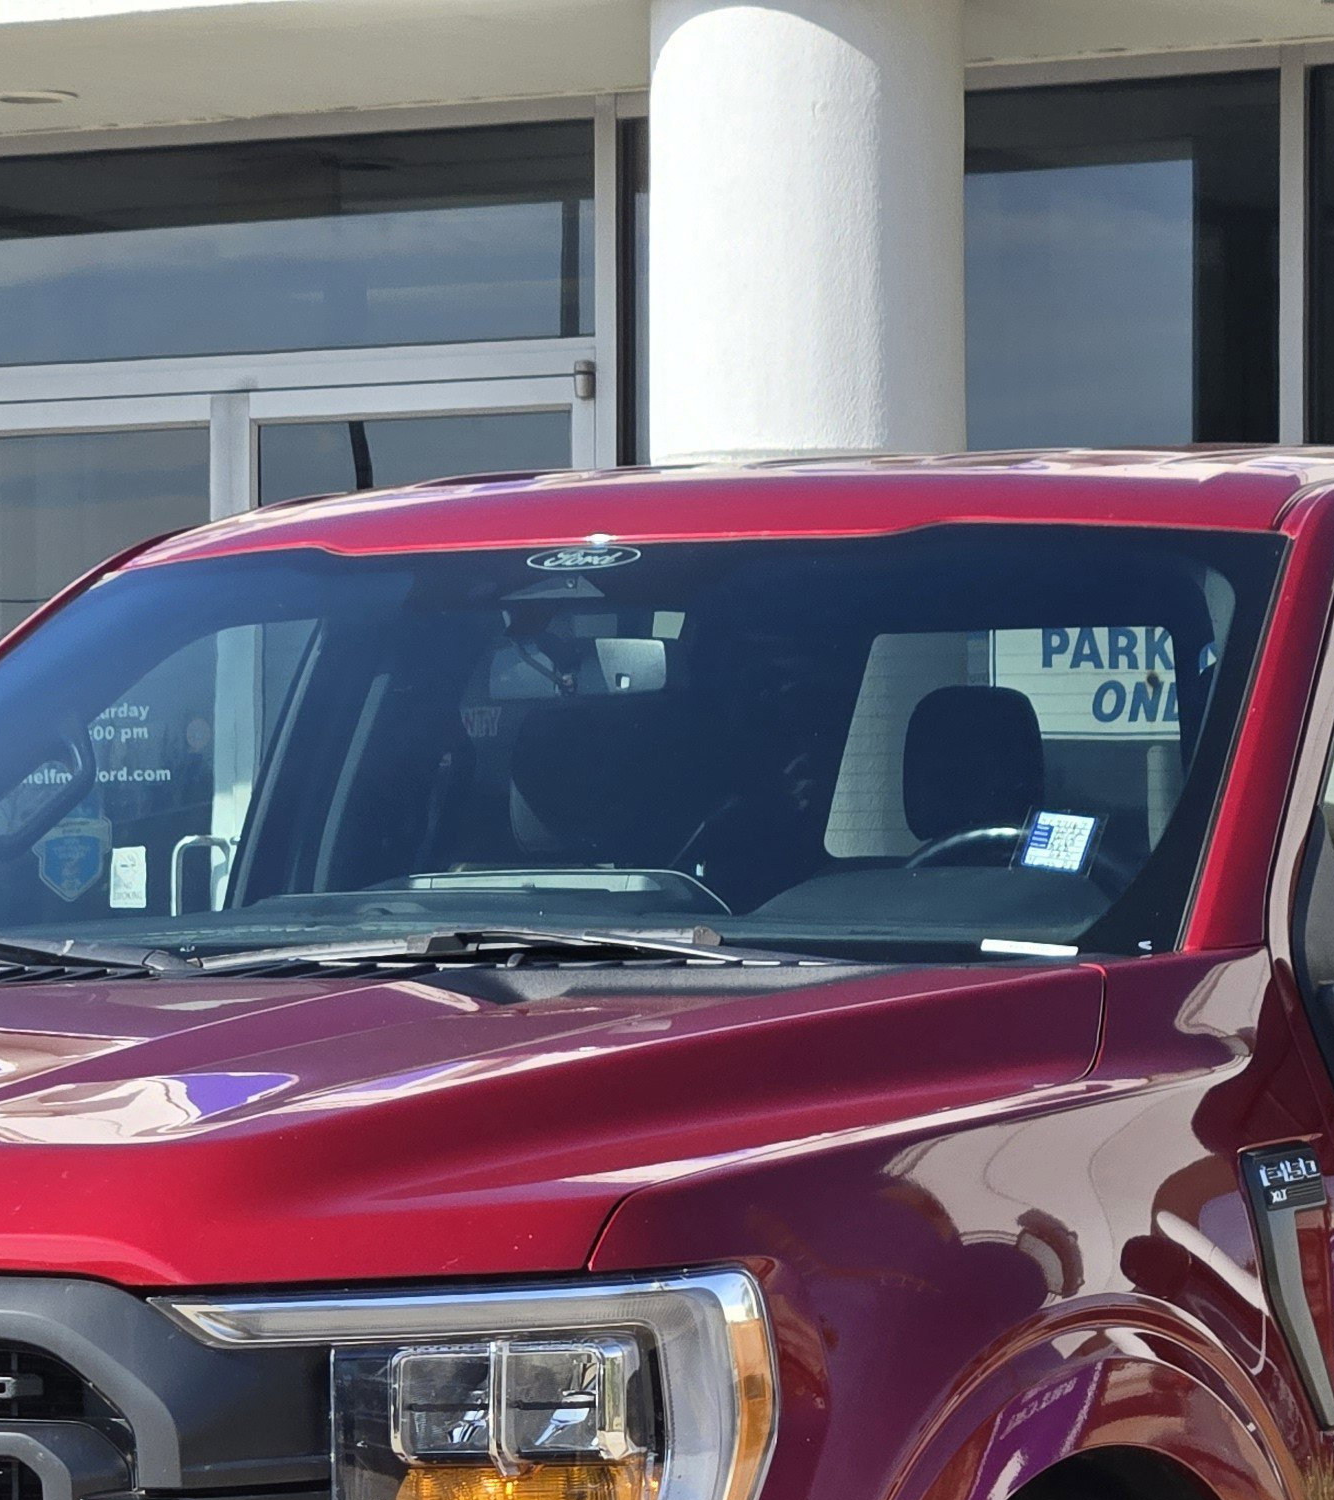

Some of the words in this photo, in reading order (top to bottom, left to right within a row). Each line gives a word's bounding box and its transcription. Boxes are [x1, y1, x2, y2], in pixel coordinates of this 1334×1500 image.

[544, 549, 623, 567] Ford
[1041, 628, 1173, 671] PARK
[1092, 680, 1179, 722] ONL
[96, 703, 149, 721] urday
[120, 726, 148, 743] pm
